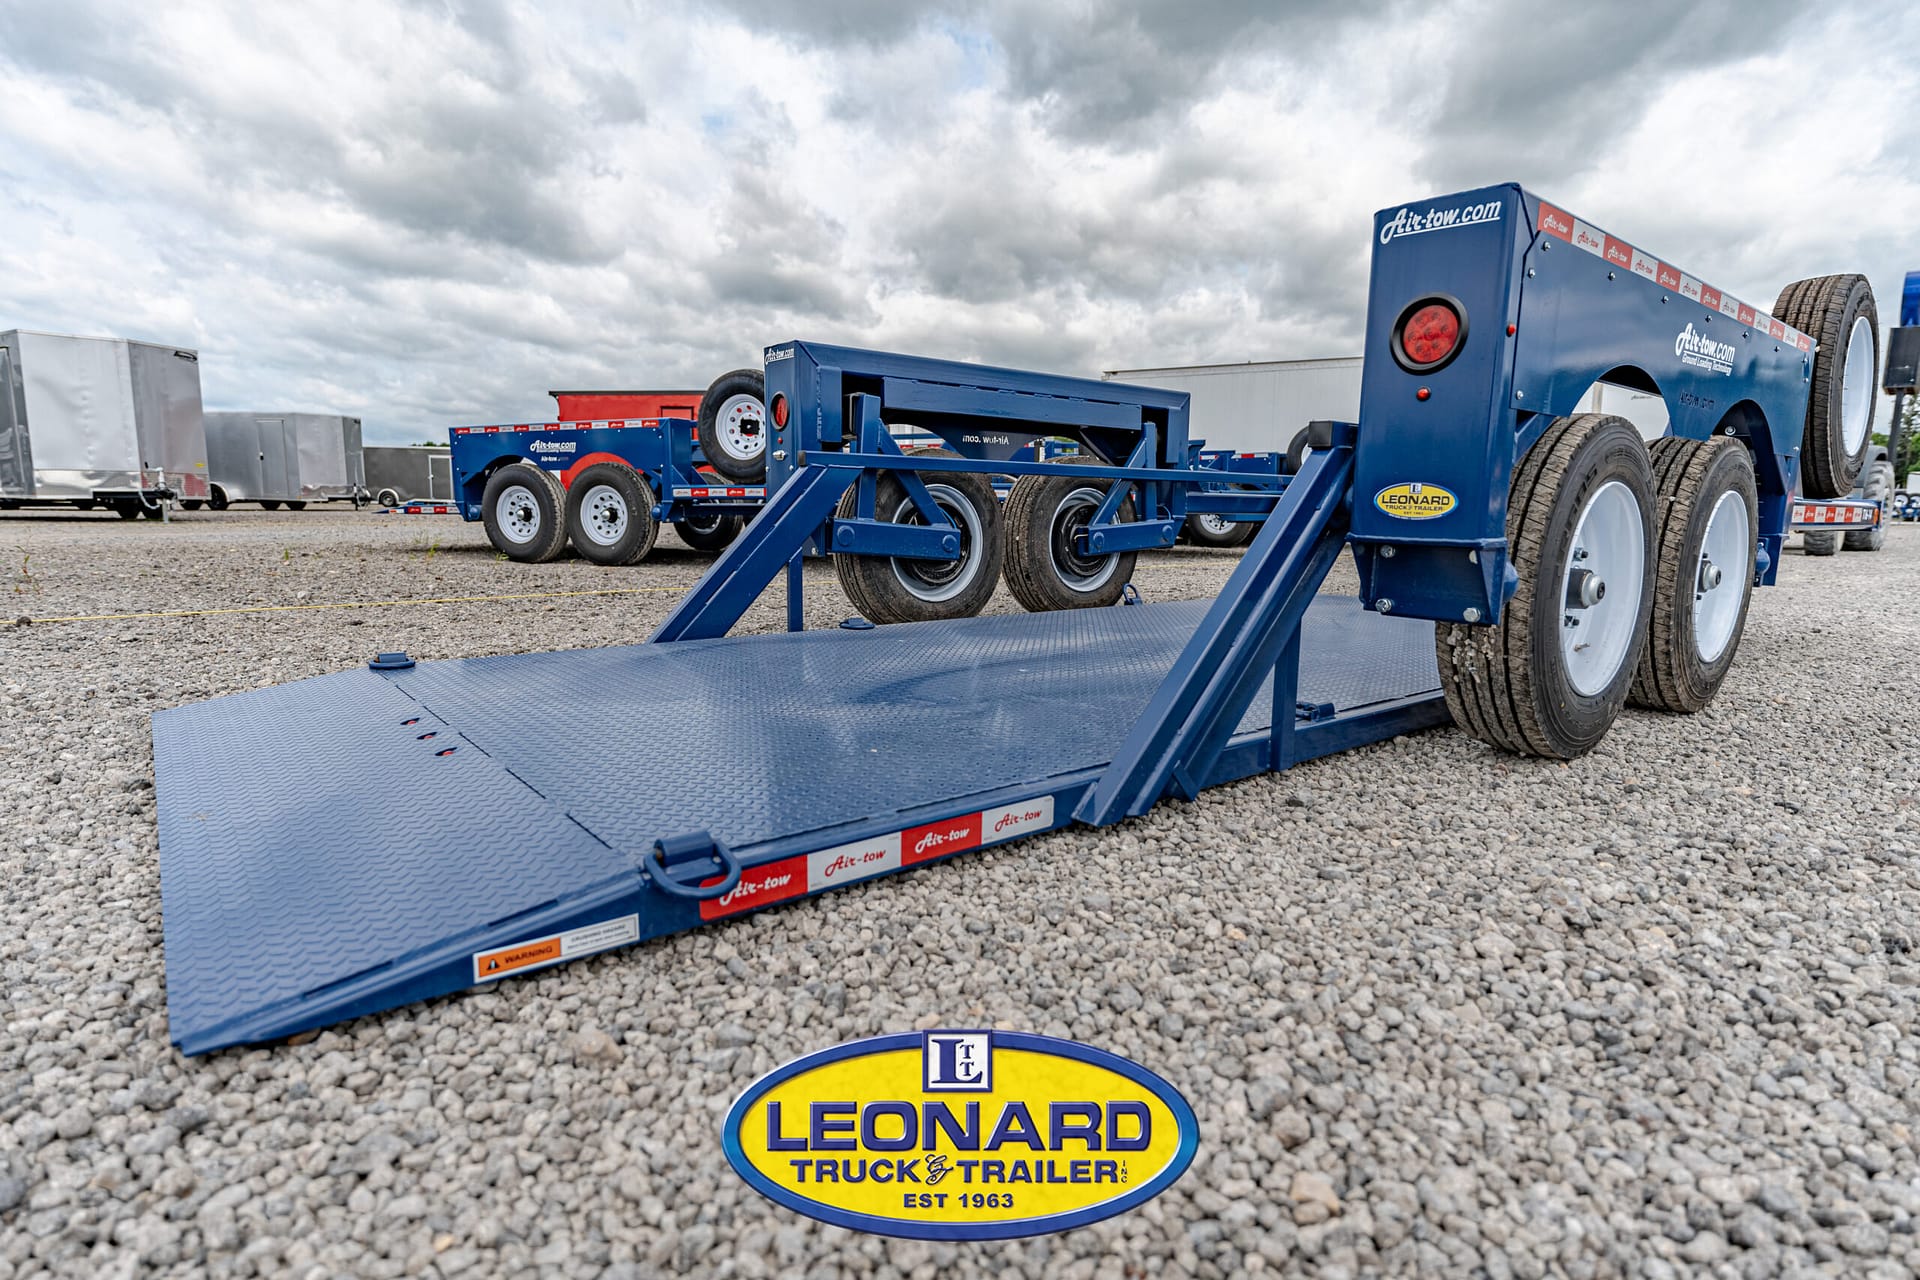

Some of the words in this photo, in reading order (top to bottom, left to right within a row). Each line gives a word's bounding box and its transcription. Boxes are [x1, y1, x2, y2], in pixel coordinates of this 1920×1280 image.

[1380, 201, 1502, 245] Air-tow.com
[1675, 322, 1736, 364] Air-tow.com
[1382, 495, 1450, 506] LEONARD
[825, 849, 886, 877] Air-tow
[915, 826, 970, 854] Air-tow
[995, 808, 1042, 832] Air-tow
[504, 945, 553, 964] WARNING
